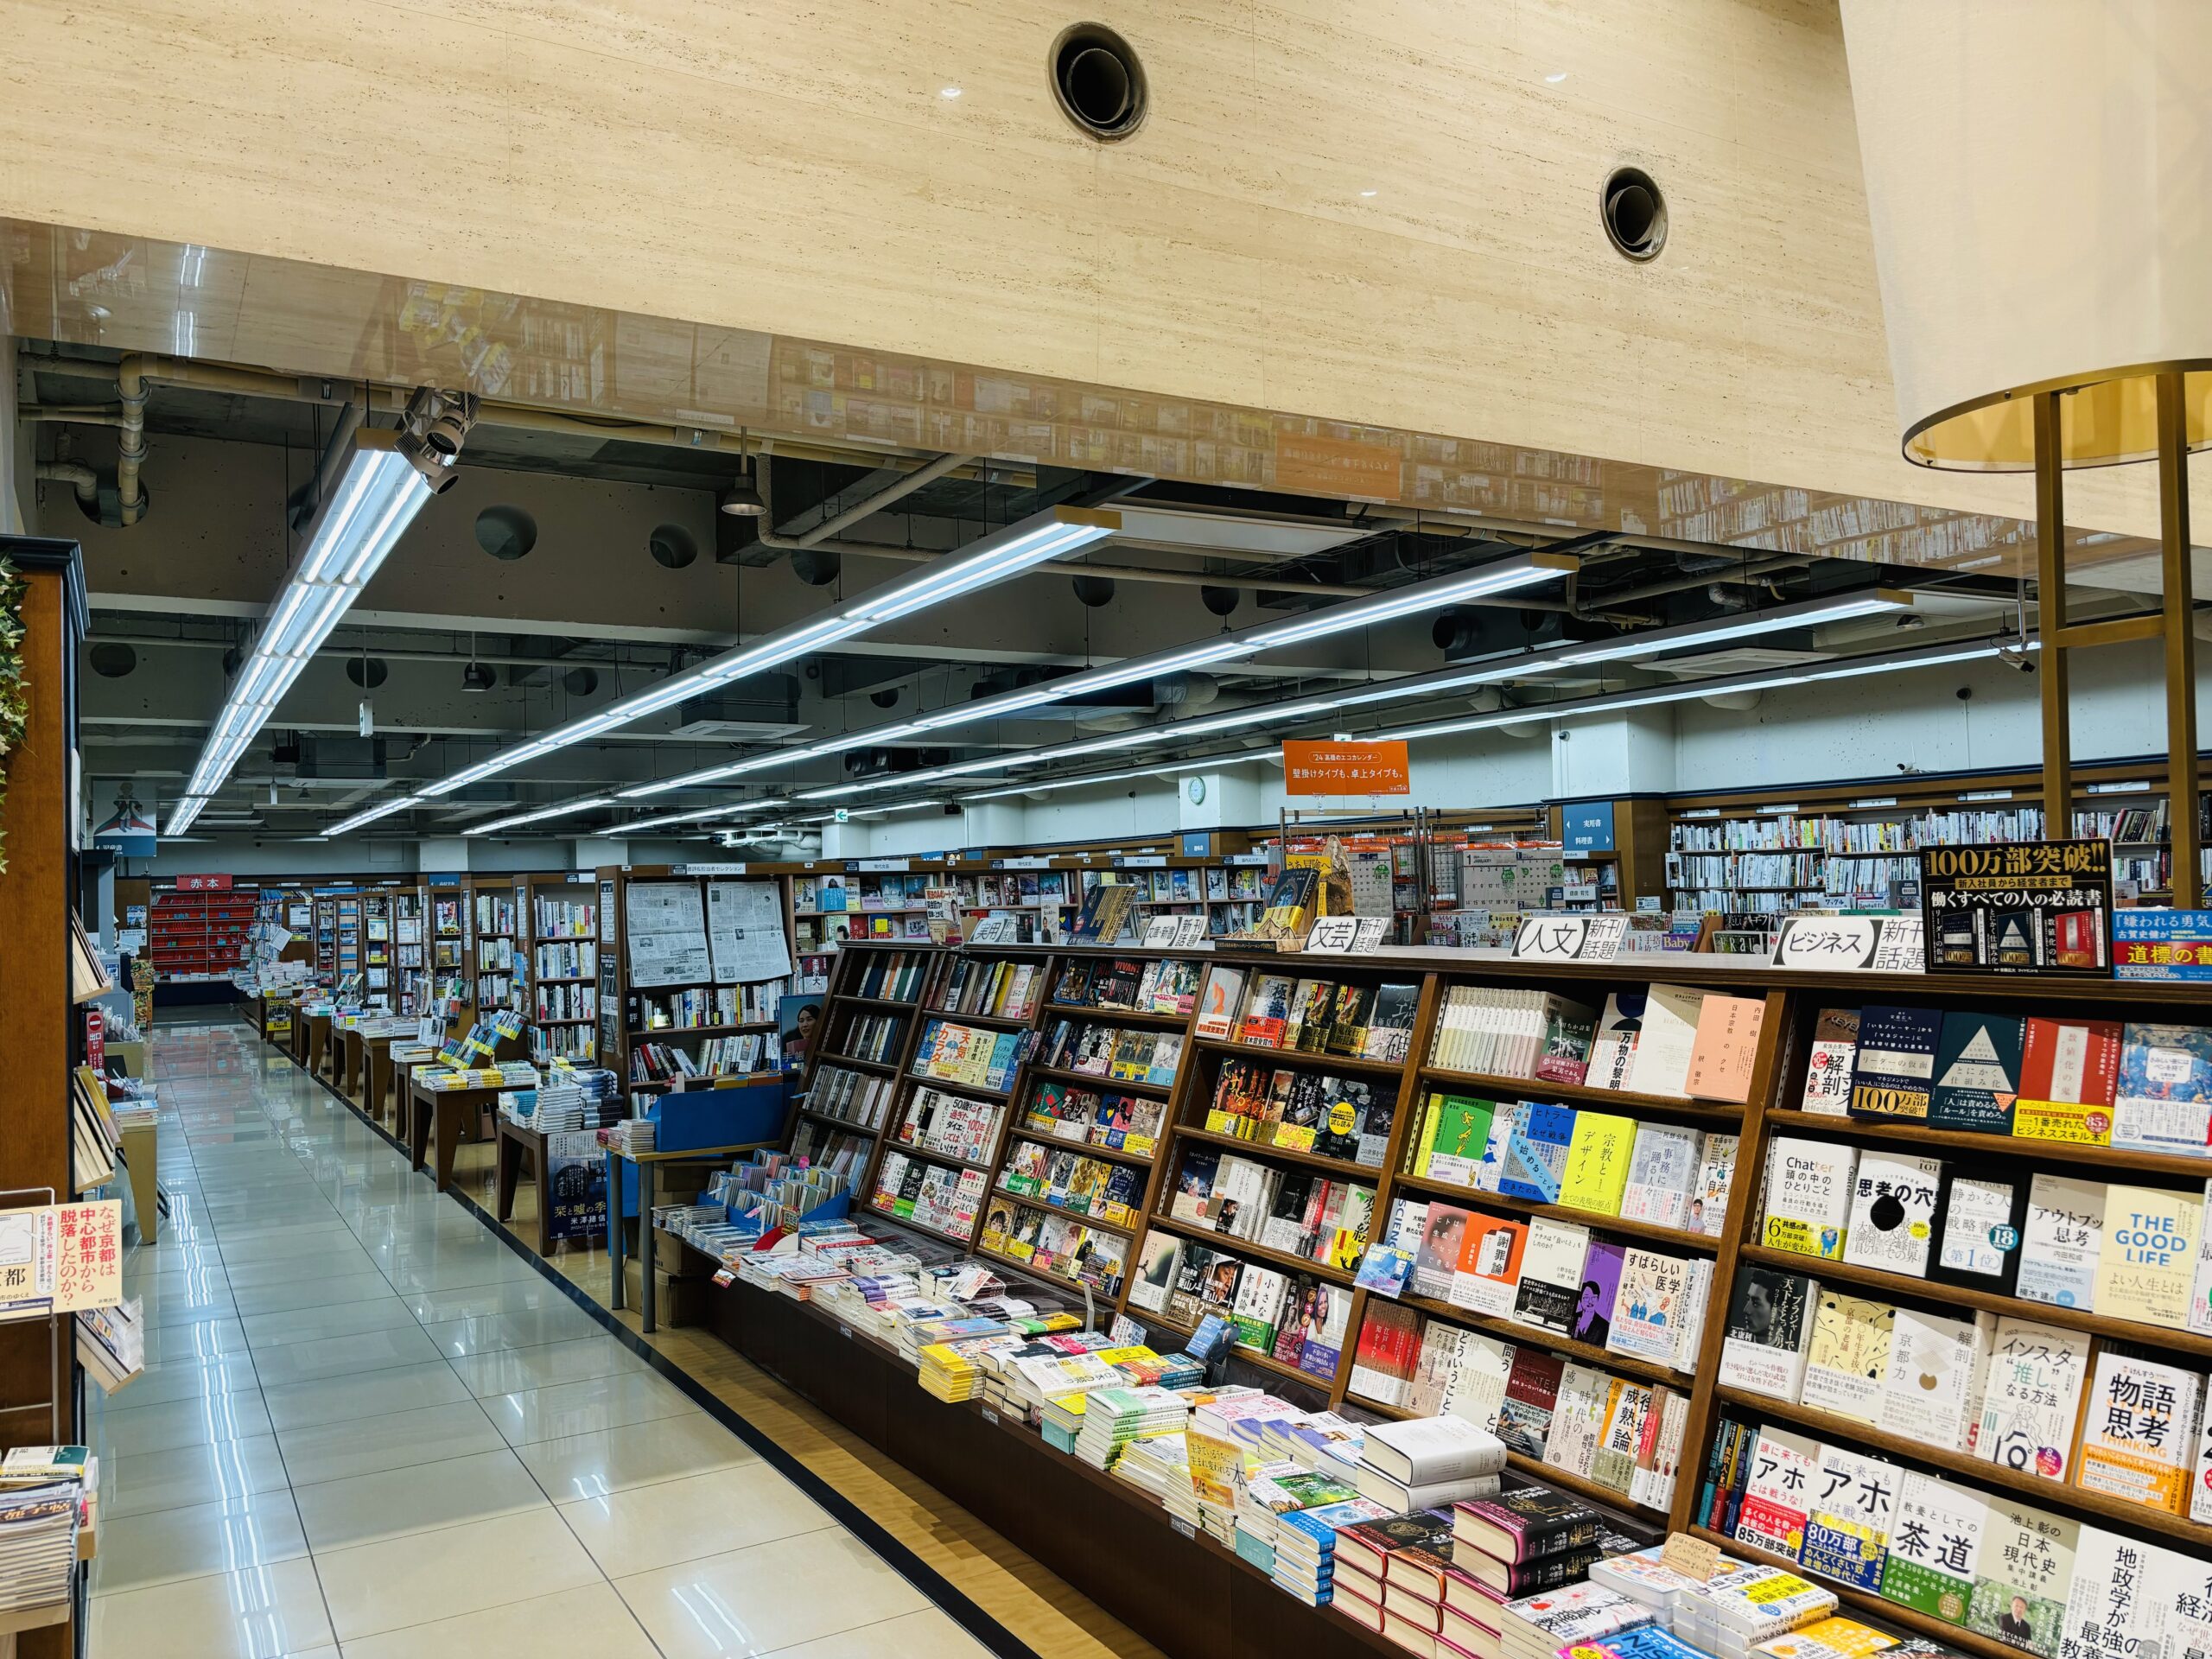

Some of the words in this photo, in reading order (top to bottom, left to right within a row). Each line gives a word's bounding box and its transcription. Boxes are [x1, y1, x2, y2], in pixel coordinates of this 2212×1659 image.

[1583, 819, 1601, 828] 実用書
[190, 878, 219, 888] 赤本
[1958, 877, 2068, 888] 新入社員から経営者まで
[1931, 889, 2101, 907] 働くすべての人の必読書
[1182, 918, 1205, 933] 新刊
[1359, 918, 1387, 936] 新刊
[1588, 918, 1626, 938] 新刊
[1351, 937, 1380, 953] 話題
[1580, 940, 1619, 960] 話題
[1663, 937, 1690, 950] Baby
[628, 996, 638, 1022] 書評
[931, 1028, 950, 1063] カラダ
[956, 1032, 972, 1058] 天気
[1610, 1032, 1633, 1090] 万物の黎明
[1862, 1056, 1928, 1070] リーダーの仮面
[1956, 1065, 1999, 1077] とにかく
[1822, 1054, 1845, 1096] 解剖
[1950, 1076, 2001, 1089] 仕組み化
[1331, 1119, 1351, 1128] 試し読み
[1535, 1109, 1572, 1121] ヒトラー
[2034, 1116, 2084, 1130] 1番売れた
[1532, 1128, 1567, 1141] なぜ戦争
[1516, 1140, 1553, 1192] を始めることが
[1575, 1131, 1596, 1185] デザイン
[1599, 1133, 1617, 1176] 宗教と
[1658, 1147, 1673, 1185] 事務に
[1786, 1156, 1834, 1173] Chatter
[1645, 1151, 1662, 1197] 踊る人々
[1785, 1169, 1832, 1185] 頭の中の
[1503, 1182, 1540, 1195] できたのか
[1784, 1181, 1830, 1197] ひとりごと
[1856, 1179, 1935, 1207] 思考の穴
[1949, 1187, 2012, 1208] 静かな人
[1436, 1217, 1459, 1228] ヒトは
[1948, 1204, 1961, 1215] の
[1769, 1217, 1781, 1238] 6
[2130, 1213, 2175, 1233] THE
[99, 1206, 116, 1276] なぜ京都は
[1767, 1239, 1818, 1255] 人生が変わる。
[1993, 1230, 2014, 1245] 18
[2054, 1227, 2090, 1246] 思考
[2115, 1230, 2187, 1252] GOOD
[60, 1209, 78, 1306] 脱落したのか?
[79, 1207, 97, 1293] 中心都市から
[1491, 1236, 1510, 1276] 謝罪論
[2126, 1248, 2172, 1267] LIFE
[1629, 1253, 1680, 1275] すばらしい
[0, 1268, 26, 1287] 都
[1656, 1275, 1681, 1294] 医学
[2109, 1272, 2184, 1295] よい人生とは
[1237, 1272, 1255, 1312] 幸福論
[1258, 1278, 1274, 1318] 小さな
[1774, 1279, 1795, 1350] 天下をとった男
[1784, 1295, 1803, 1351] ブラジャーで
[1730, 1329, 1752, 1342] 北康利
[1955, 1331, 1974, 1364] 解剖
[1502, 1344, 1515, 1372] 問う
[1891, 1333, 1914, 1381] 京都力
[2003, 1338, 2077, 1370] インスタで
[1440, 1332, 1469, 1416] どういうこと
[2129, 1368, 2155, 1380] けんすう
[2006, 1382, 2058, 1408] なる方法
[2108, 1372, 2177, 1414] 物語
[1573, 1390, 1591, 1434] 時代の
[1612, 1389, 1637, 1453] 成熟論
[2102, 1407, 2171, 1449] 思考
[1761, 1442, 1811, 1467] 頭に来ても
[1230, 1462, 1247, 1491] 本
[1757, 1457, 1806, 1490] アホ
[1827, 1456, 1891, 1485] 頭に来ても
[1750, 1481, 1803, 1509] とは戦うな!
[1820, 1467, 1891, 1514] アホ
[1819, 1499, 1886, 1529] とは戦うな!
[1904, 1502, 1978, 1533] 教養としての
[1738, 1527, 1798, 1560] 85万部突破
[1808, 1523, 1857, 1551] 80万部
[1895, 1519, 1974, 1575] 茶道
[2018, 1532, 2050, 1554] 日本
[1802, 1556, 1860, 1584] 激増の時代に
[2003, 1544, 2056, 1576] 現代史
[2006, 1563, 2048, 1585] 集中講義
[2107, 1546, 2137, 1628] 地政学が
[2080, 1620, 2143, 1655] 最強の
